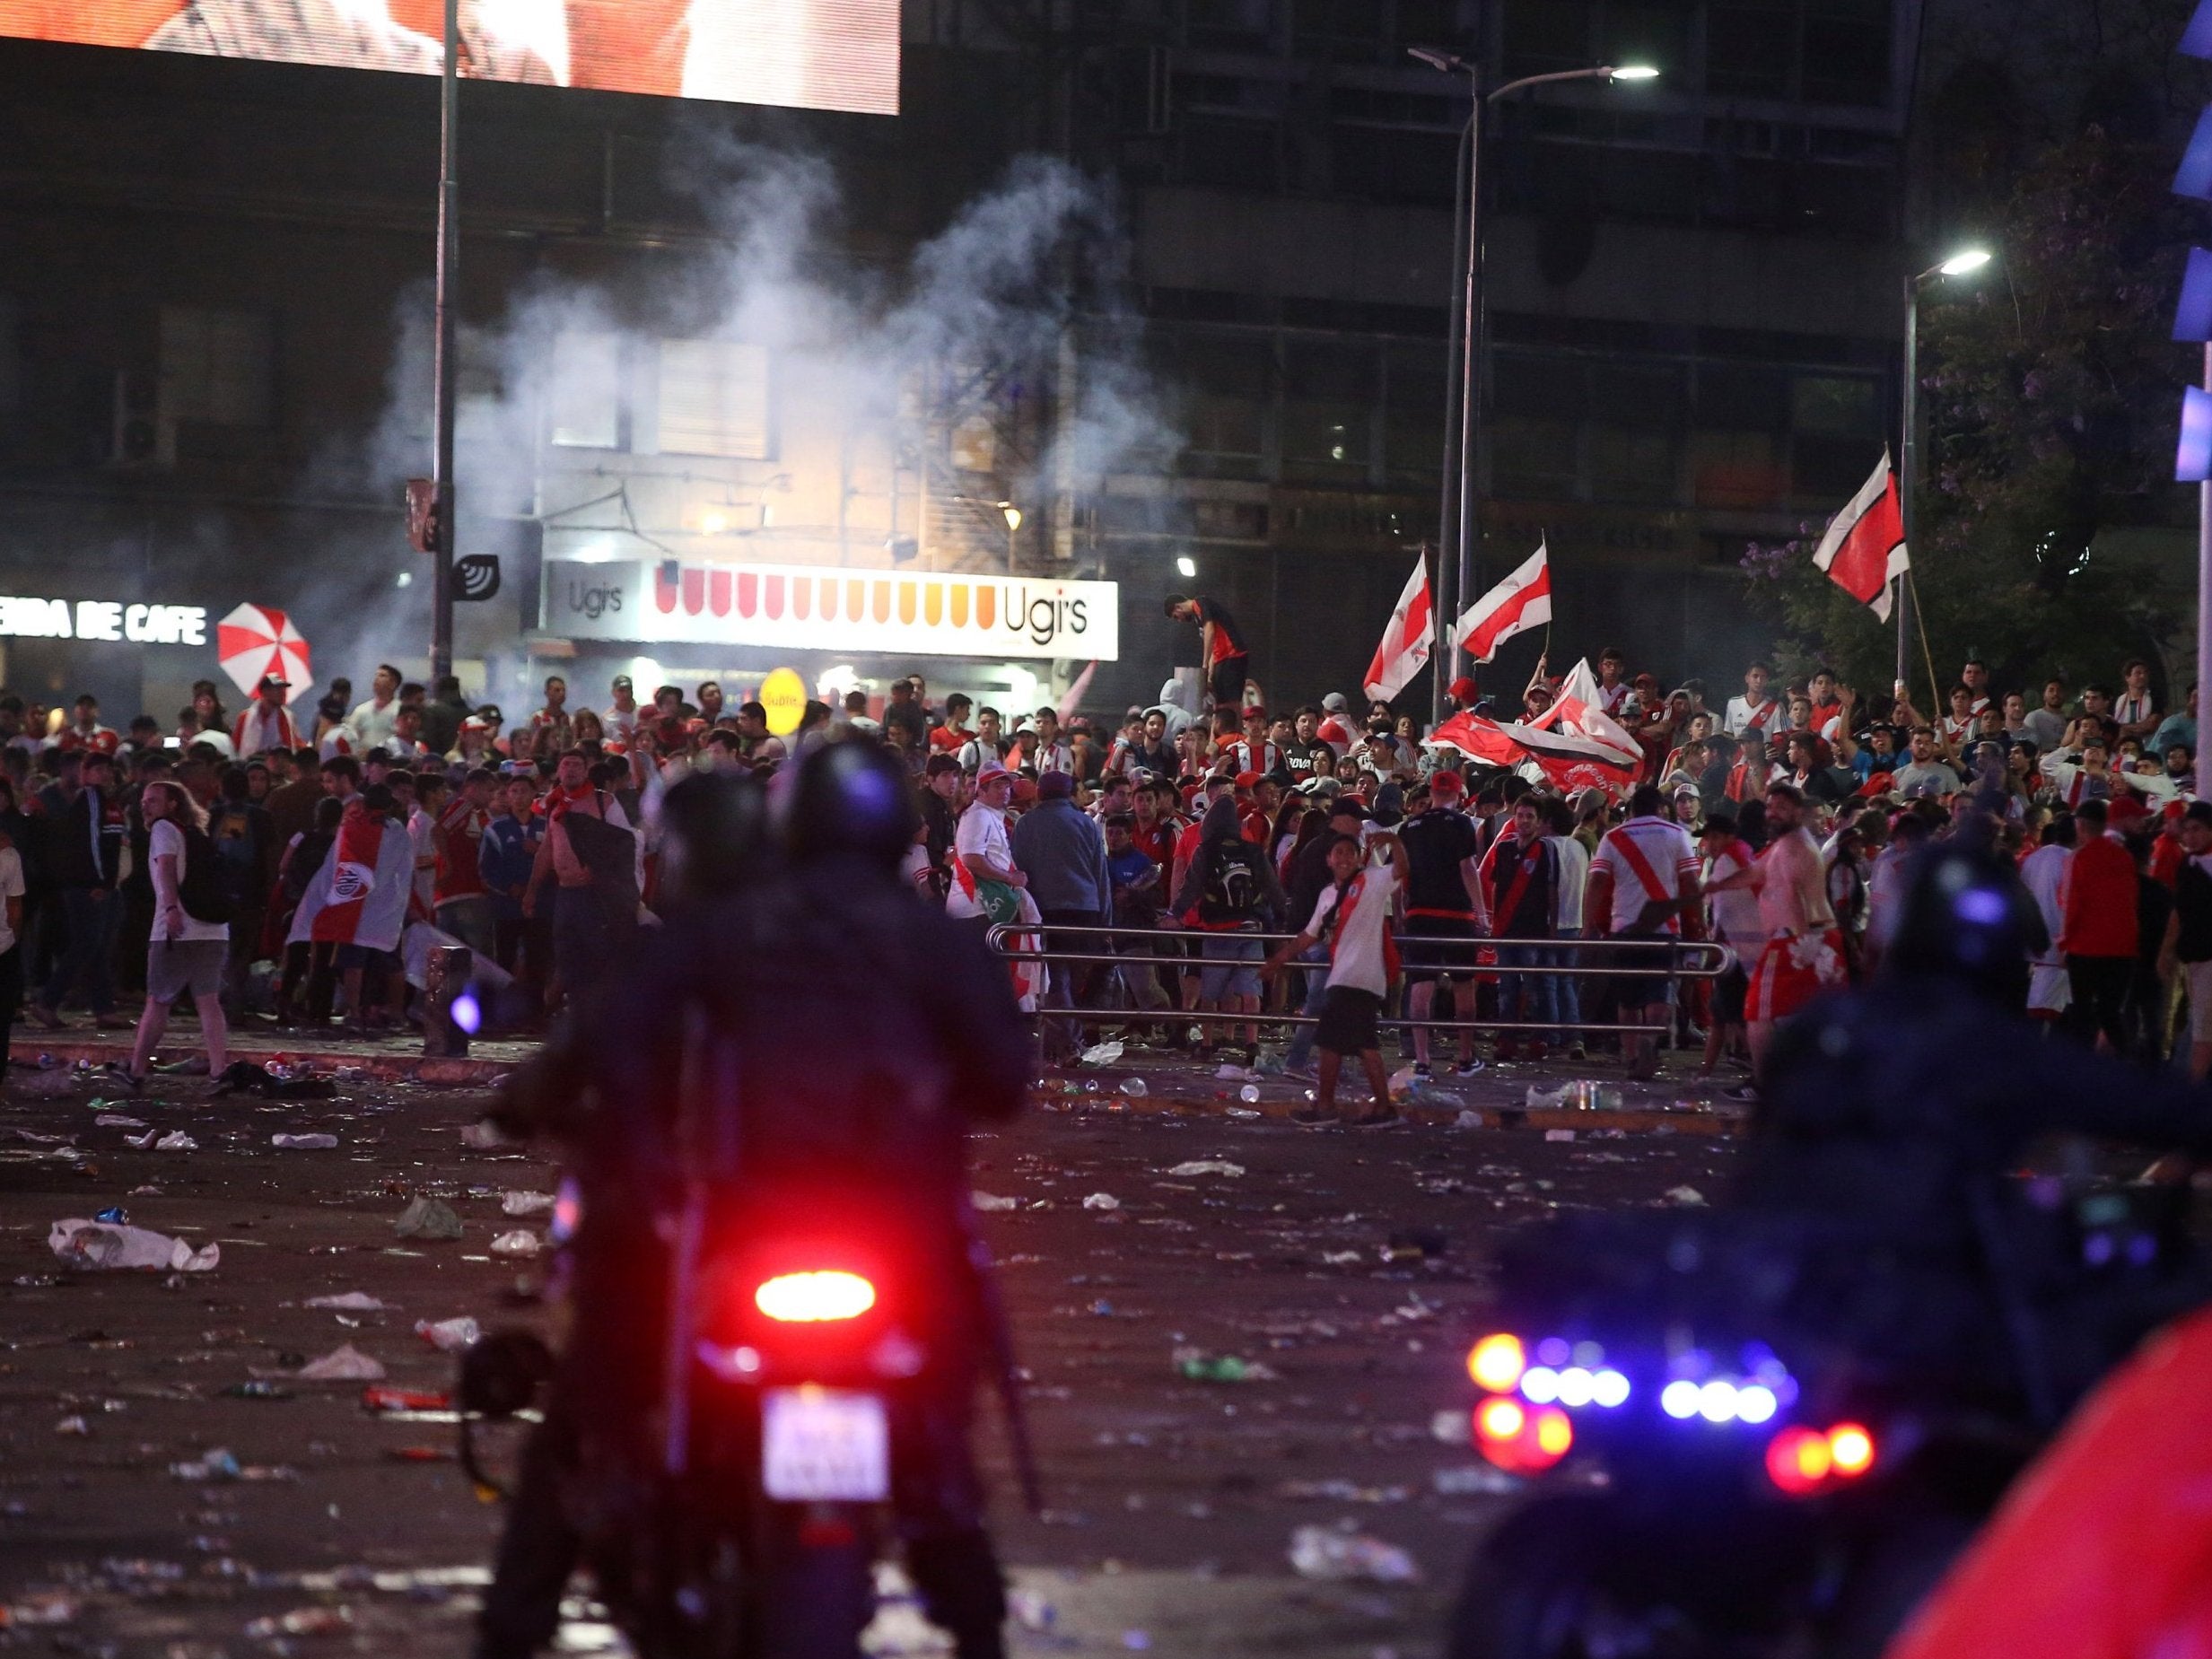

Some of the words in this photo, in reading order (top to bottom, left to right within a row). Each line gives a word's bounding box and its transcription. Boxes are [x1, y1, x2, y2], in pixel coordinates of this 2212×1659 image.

[75, 600, 123, 641] DE
[569, 581, 622, 619] Ugi's
[1005, 586, 1087, 645] Ugi's
